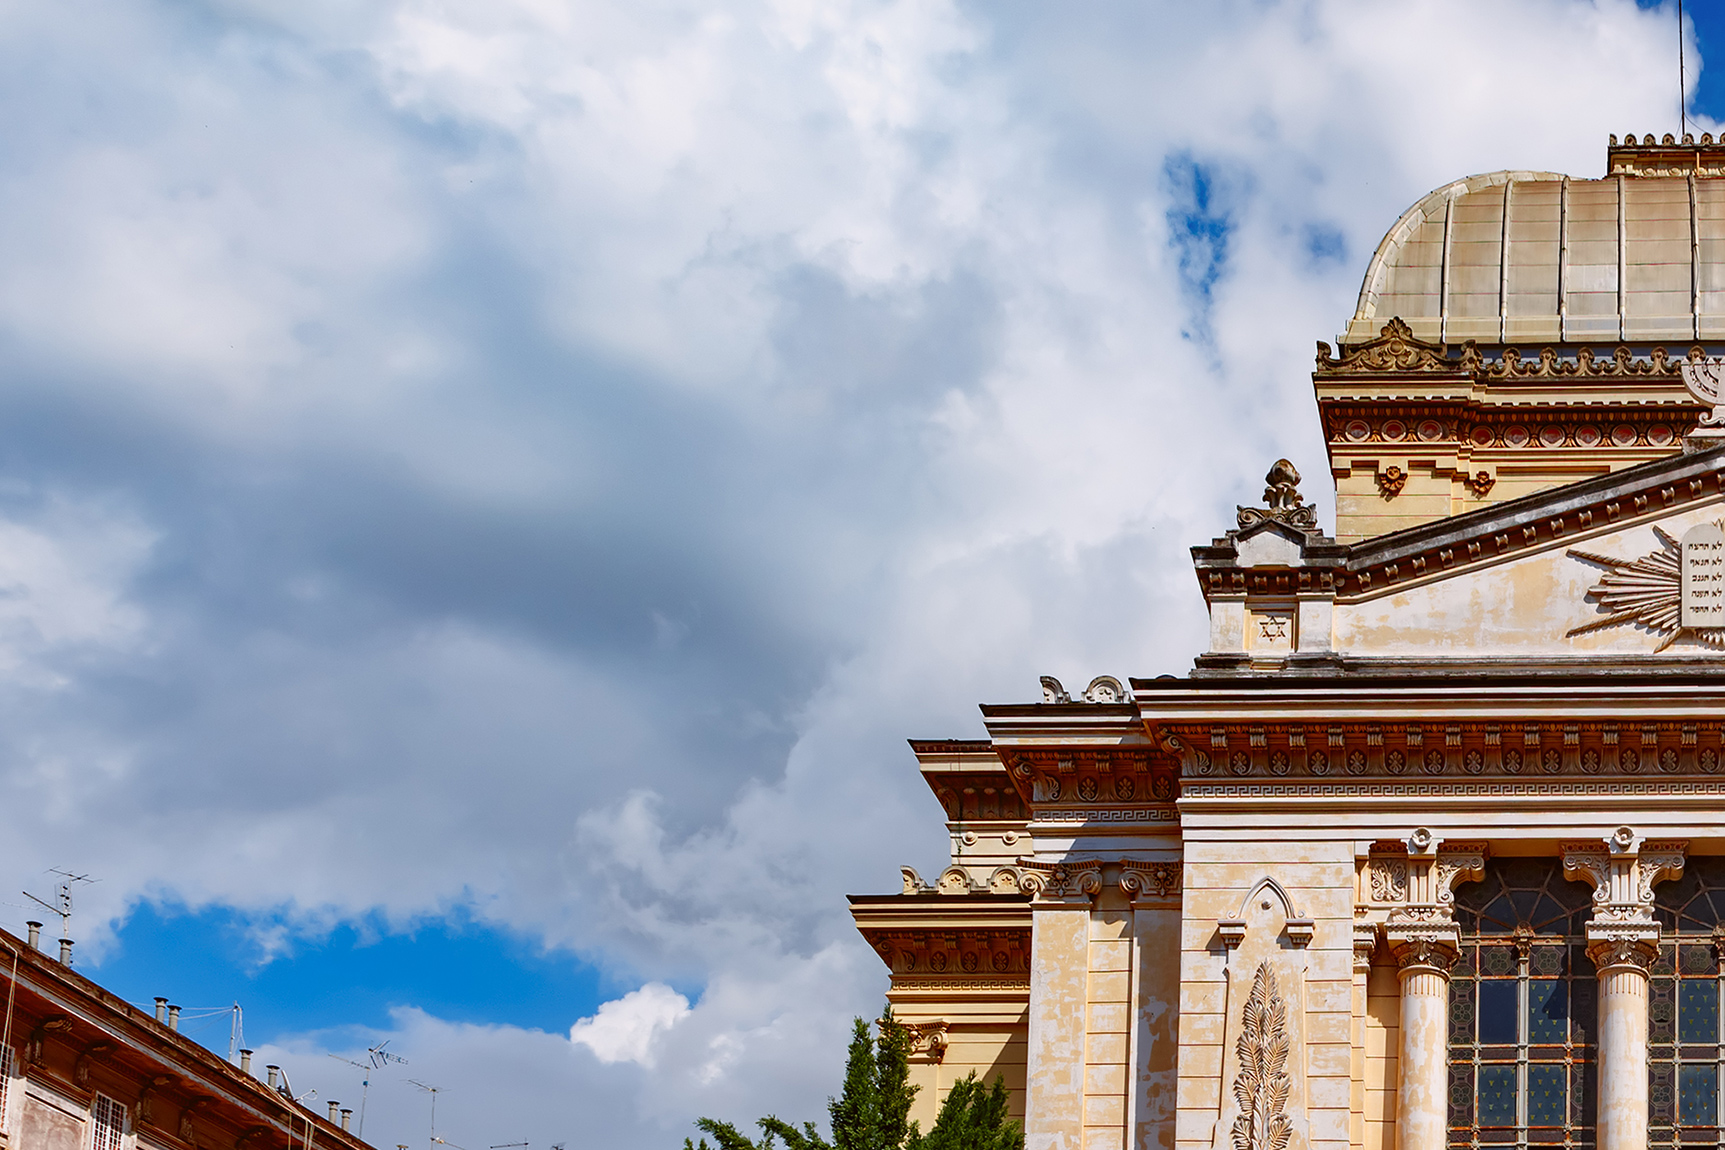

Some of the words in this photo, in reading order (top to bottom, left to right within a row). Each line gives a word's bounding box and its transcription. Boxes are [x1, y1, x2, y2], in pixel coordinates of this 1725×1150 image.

[1712, 541, 1722, 550] לא
[1690, 559, 1709, 567] תנאף
[1712, 556, 1722, 566] לא
[1712, 572, 1722, 581] לא
[1692, 591, 1709, 599] תענה
[1712, 588, 1722, 597] לא
[1712, 604, 1722, 613] לא
